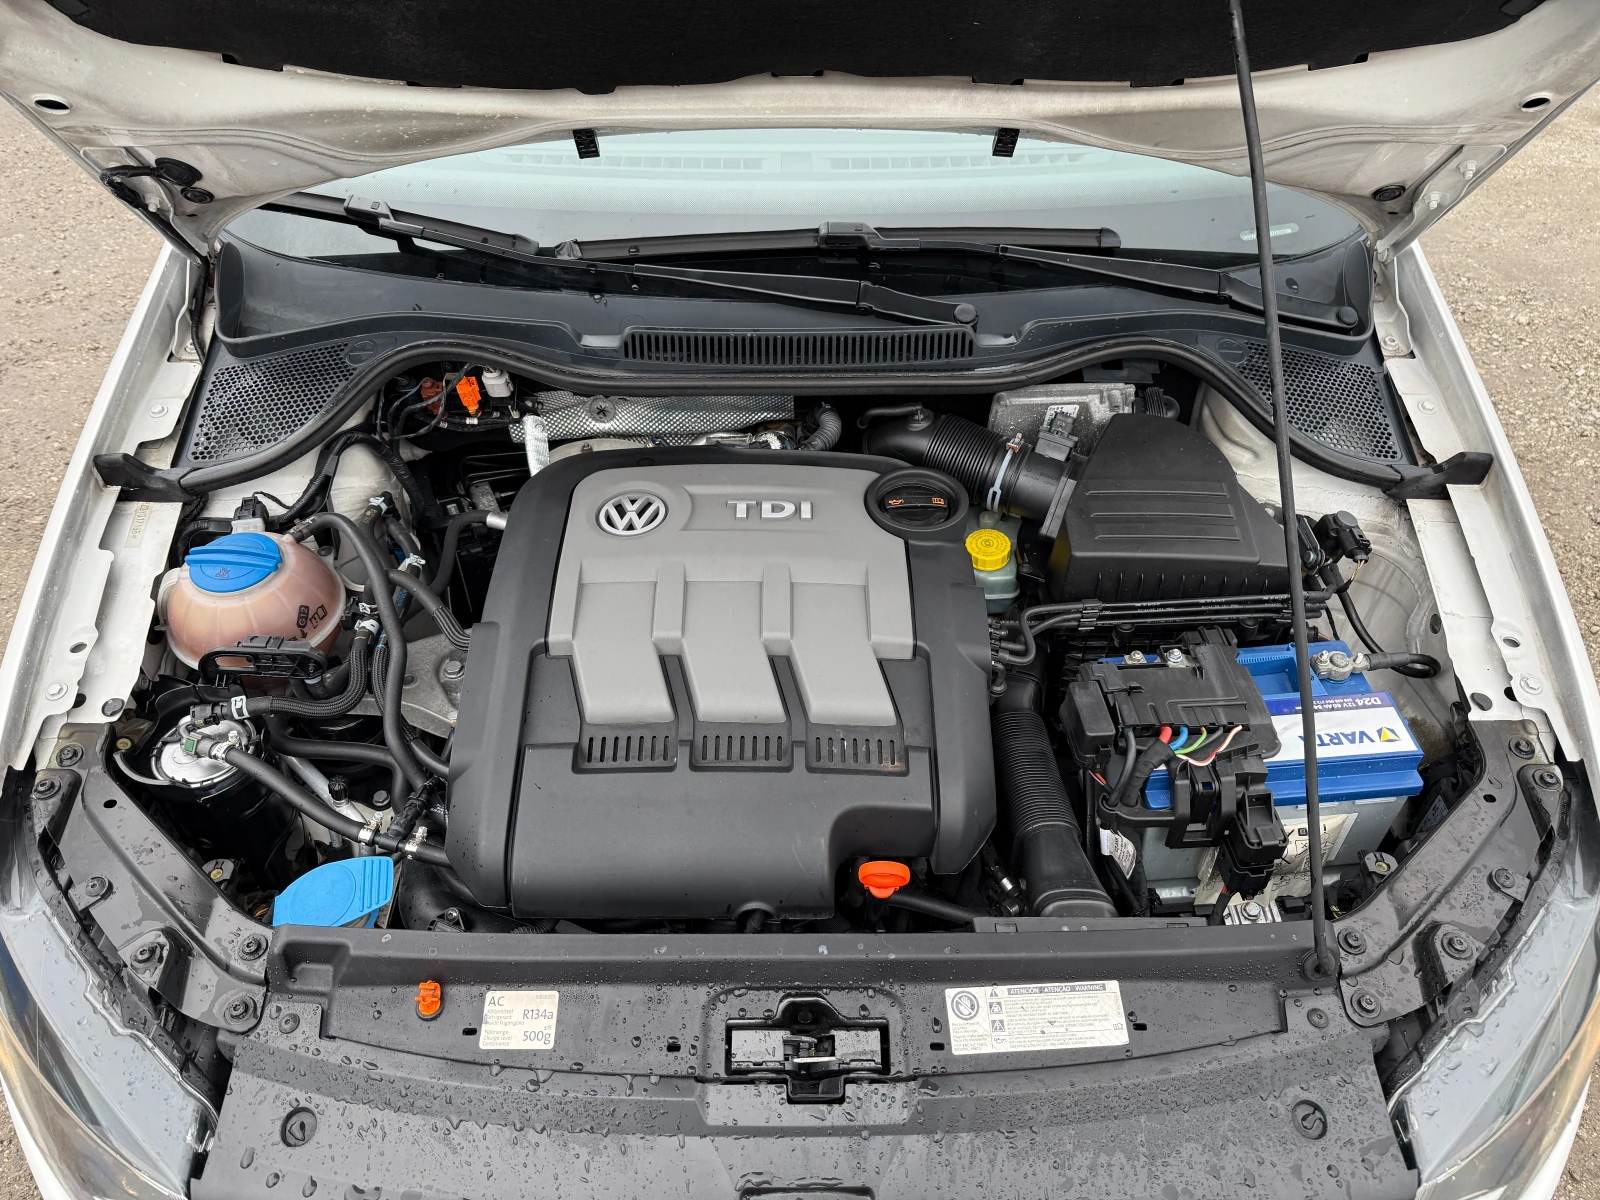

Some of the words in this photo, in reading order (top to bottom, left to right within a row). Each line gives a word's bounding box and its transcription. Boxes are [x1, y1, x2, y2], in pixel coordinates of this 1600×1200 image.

[727, 500, 813, 520] TDI
[298, 606, 308, 626] G12
[1355, 696, 1382, 706] D24
[1298, 730, 1376, 747] VART
[1010, 986, 1039, 995] ATENCIÓN
[1075, 983, 1104, 992] WARNING
[487, 995, 505, 1007] AC
[522, 1008, 554, 1020] R134a
[522, 1030, 552, 1045] 500g
